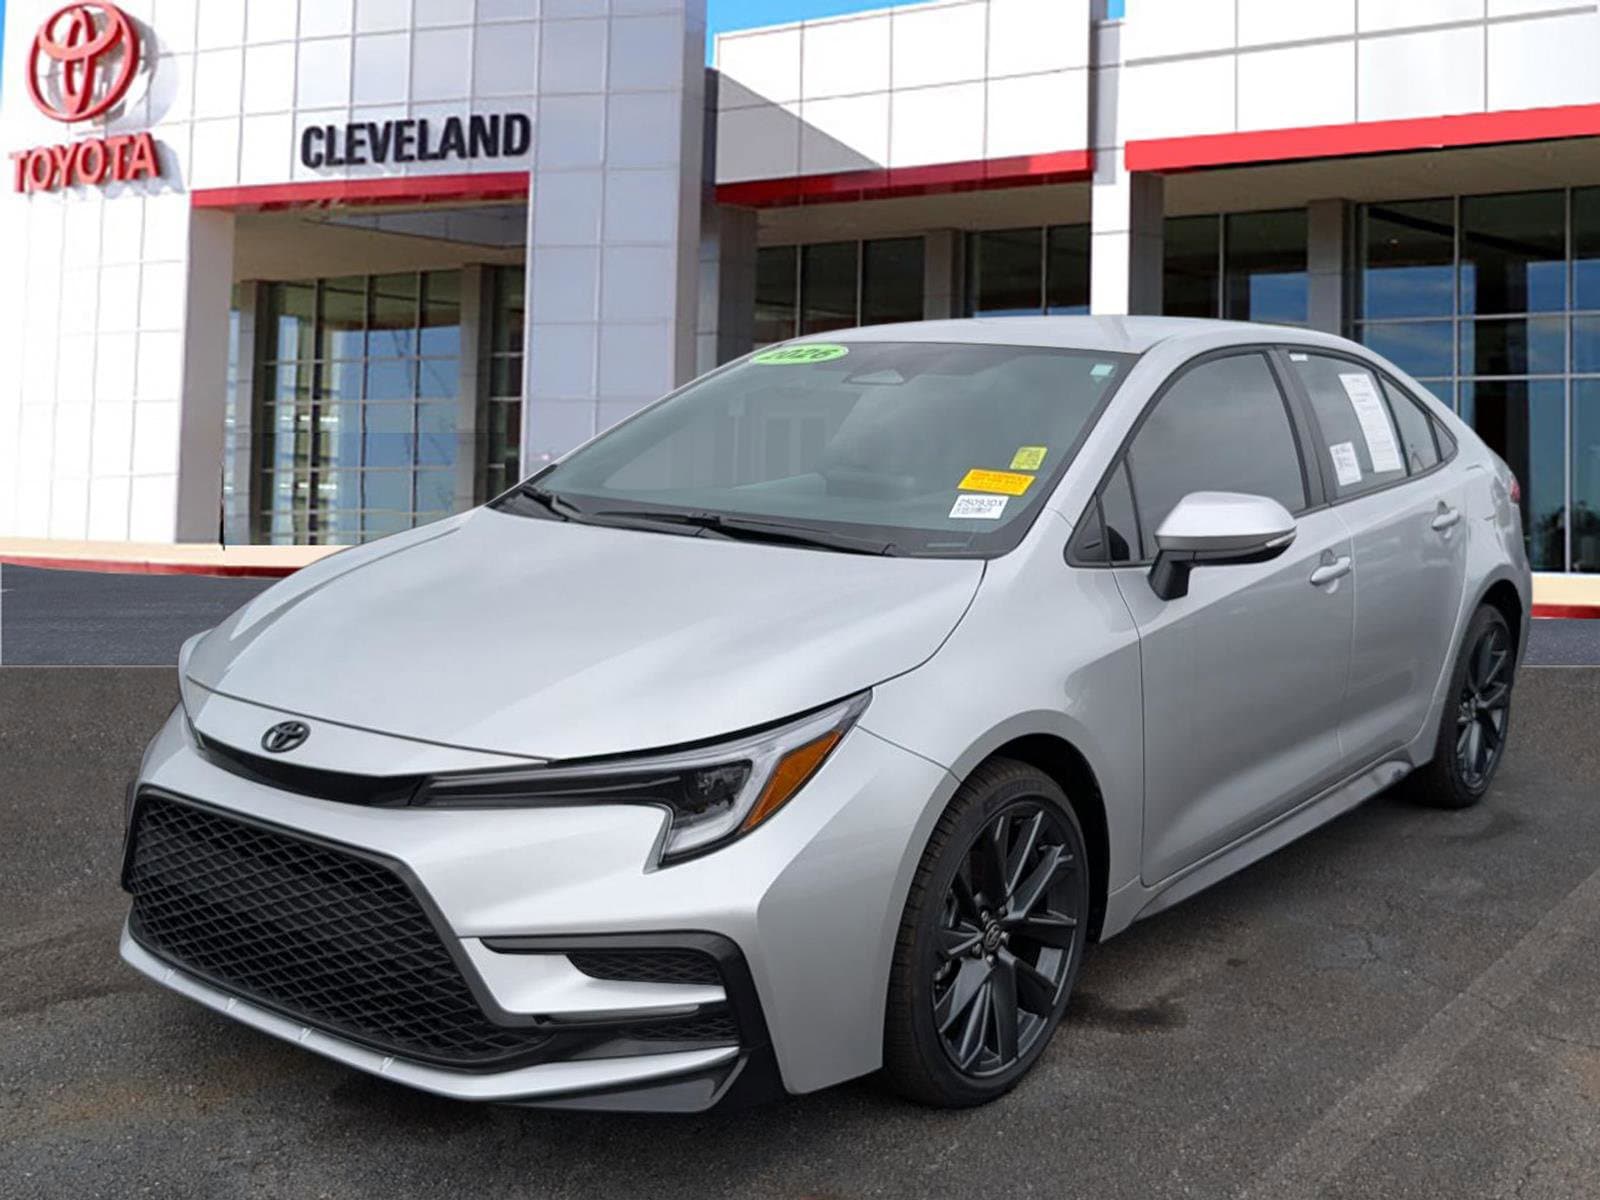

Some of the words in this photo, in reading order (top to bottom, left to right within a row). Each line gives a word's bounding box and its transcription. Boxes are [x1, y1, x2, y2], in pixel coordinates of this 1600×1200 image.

[9, 131, 161, 193] TOYOTA
[300, 113, 531, 169] CLEVELAND
[758, 348, 839, 361] 2026
